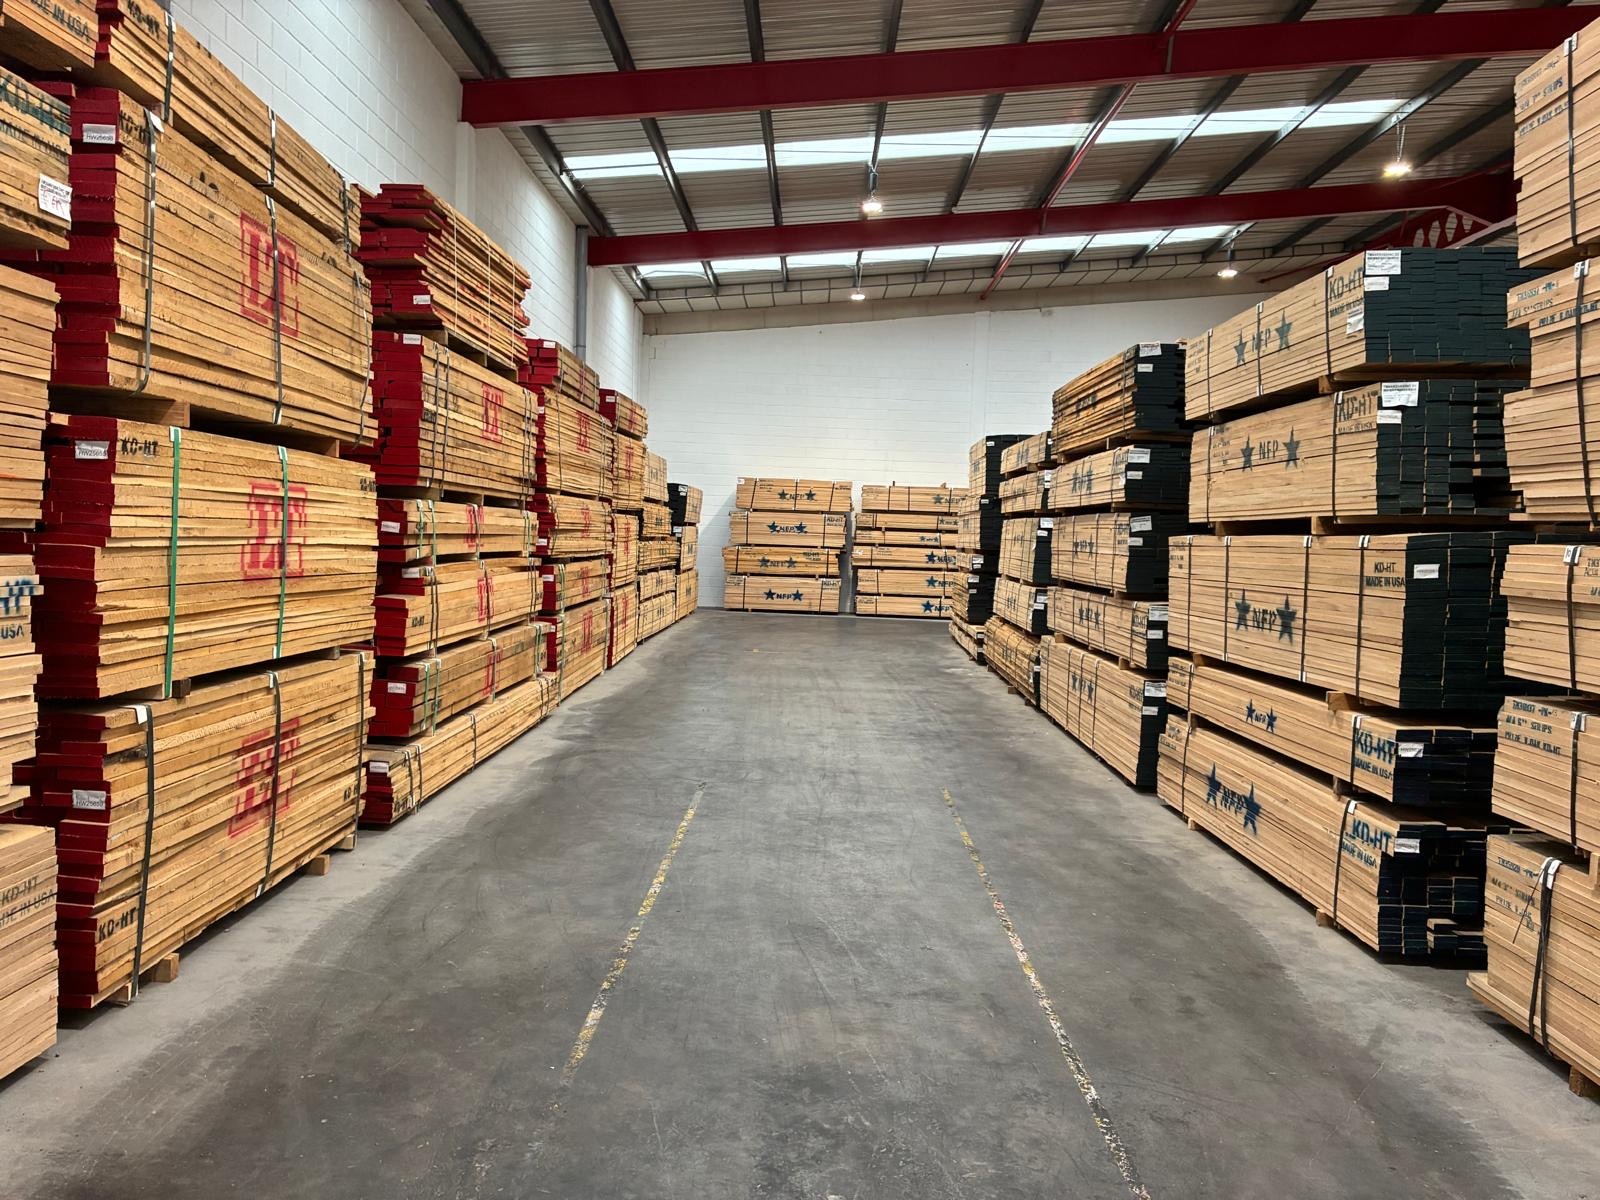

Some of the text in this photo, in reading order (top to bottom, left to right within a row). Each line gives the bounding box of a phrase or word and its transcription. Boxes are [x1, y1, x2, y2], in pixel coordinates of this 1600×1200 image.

[67, 14, 91, 43] USA
[1329, 267, 1364, 301] KD-HT
[1338, 390, 1378, 422] KD-HT
[121, 437, 158, 456] KD-HT
[1260, 440, 1278, 459] NFP
[1374, 562, 1396, 573] KD-HT
[1365, 576, 1406, 587] MADE IN USA
[1253, 607, 1277, 632] NFP
[1, 625, 25, 639] USA
[1354, 727, 1395, 764] KD-HT
[1379, 767, 1393, 780] USA
[1353, 818, 1392, 853] KD-HT
[1364, 853, 1378, 868] USA
[1, 875, 40, 906] KD-HT
[34, 889, 55, 909] USA
[98, 906, 137, 941] KD-HT
